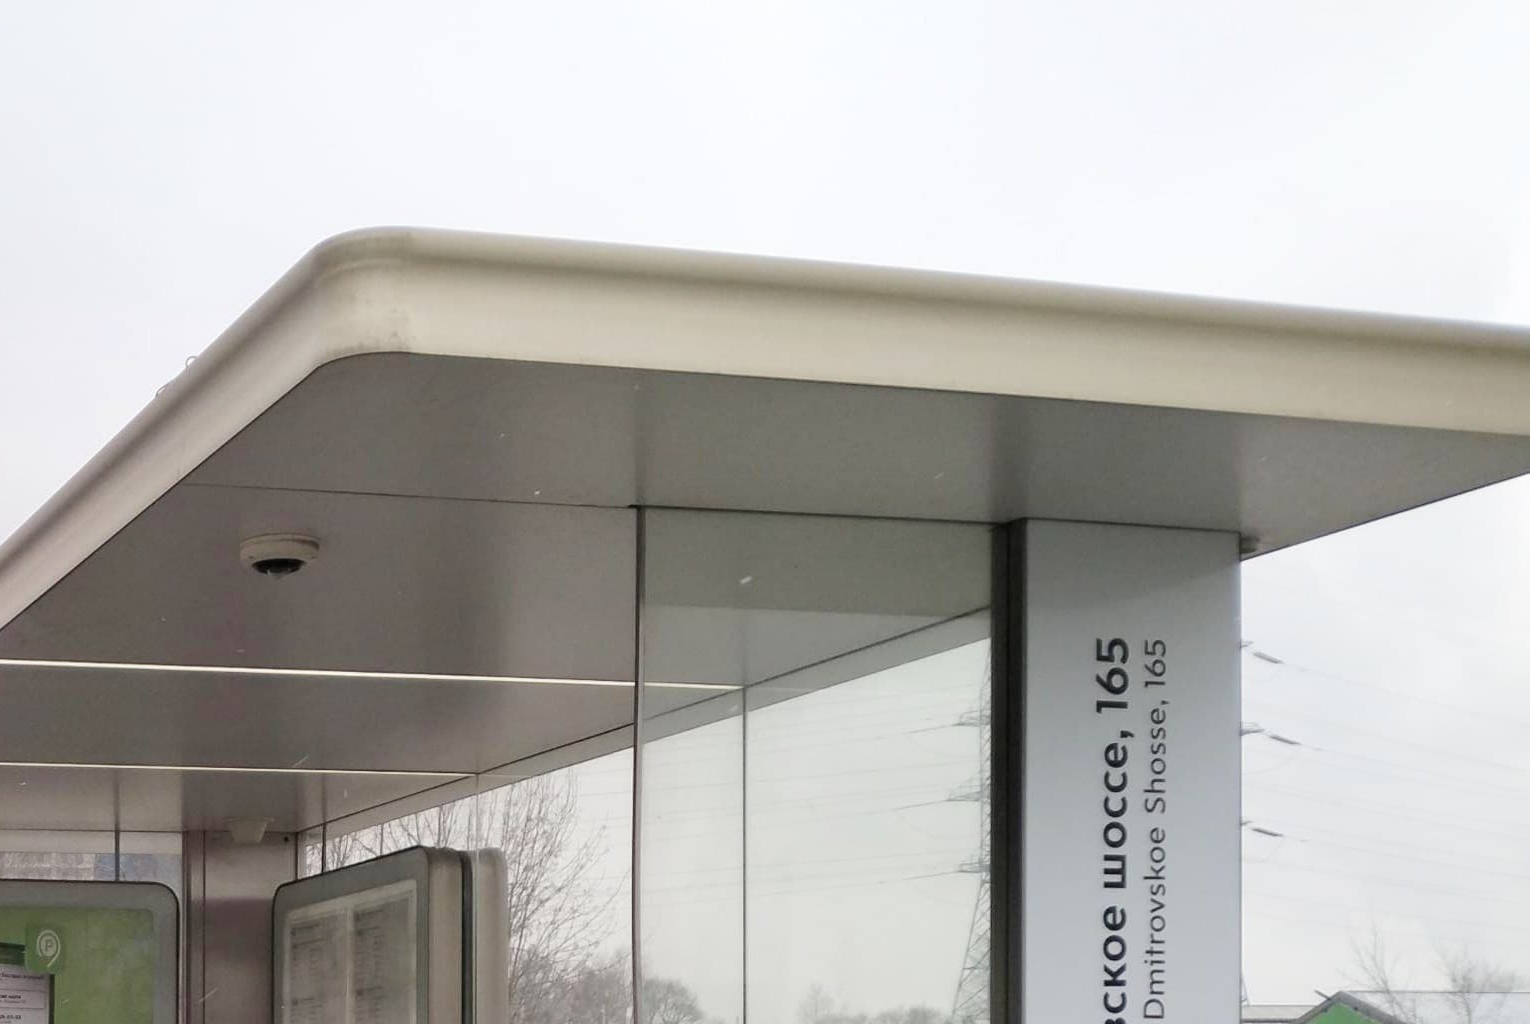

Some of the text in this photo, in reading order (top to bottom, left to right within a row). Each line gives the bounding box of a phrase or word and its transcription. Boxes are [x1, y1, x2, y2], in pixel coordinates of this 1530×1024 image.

[1095, 637, 1129, 714] 165
[1103, 730, 1135, 889] шоссе,
[1143, 639, 1170, 1019] Dmitrovskoe Shosse, 165
